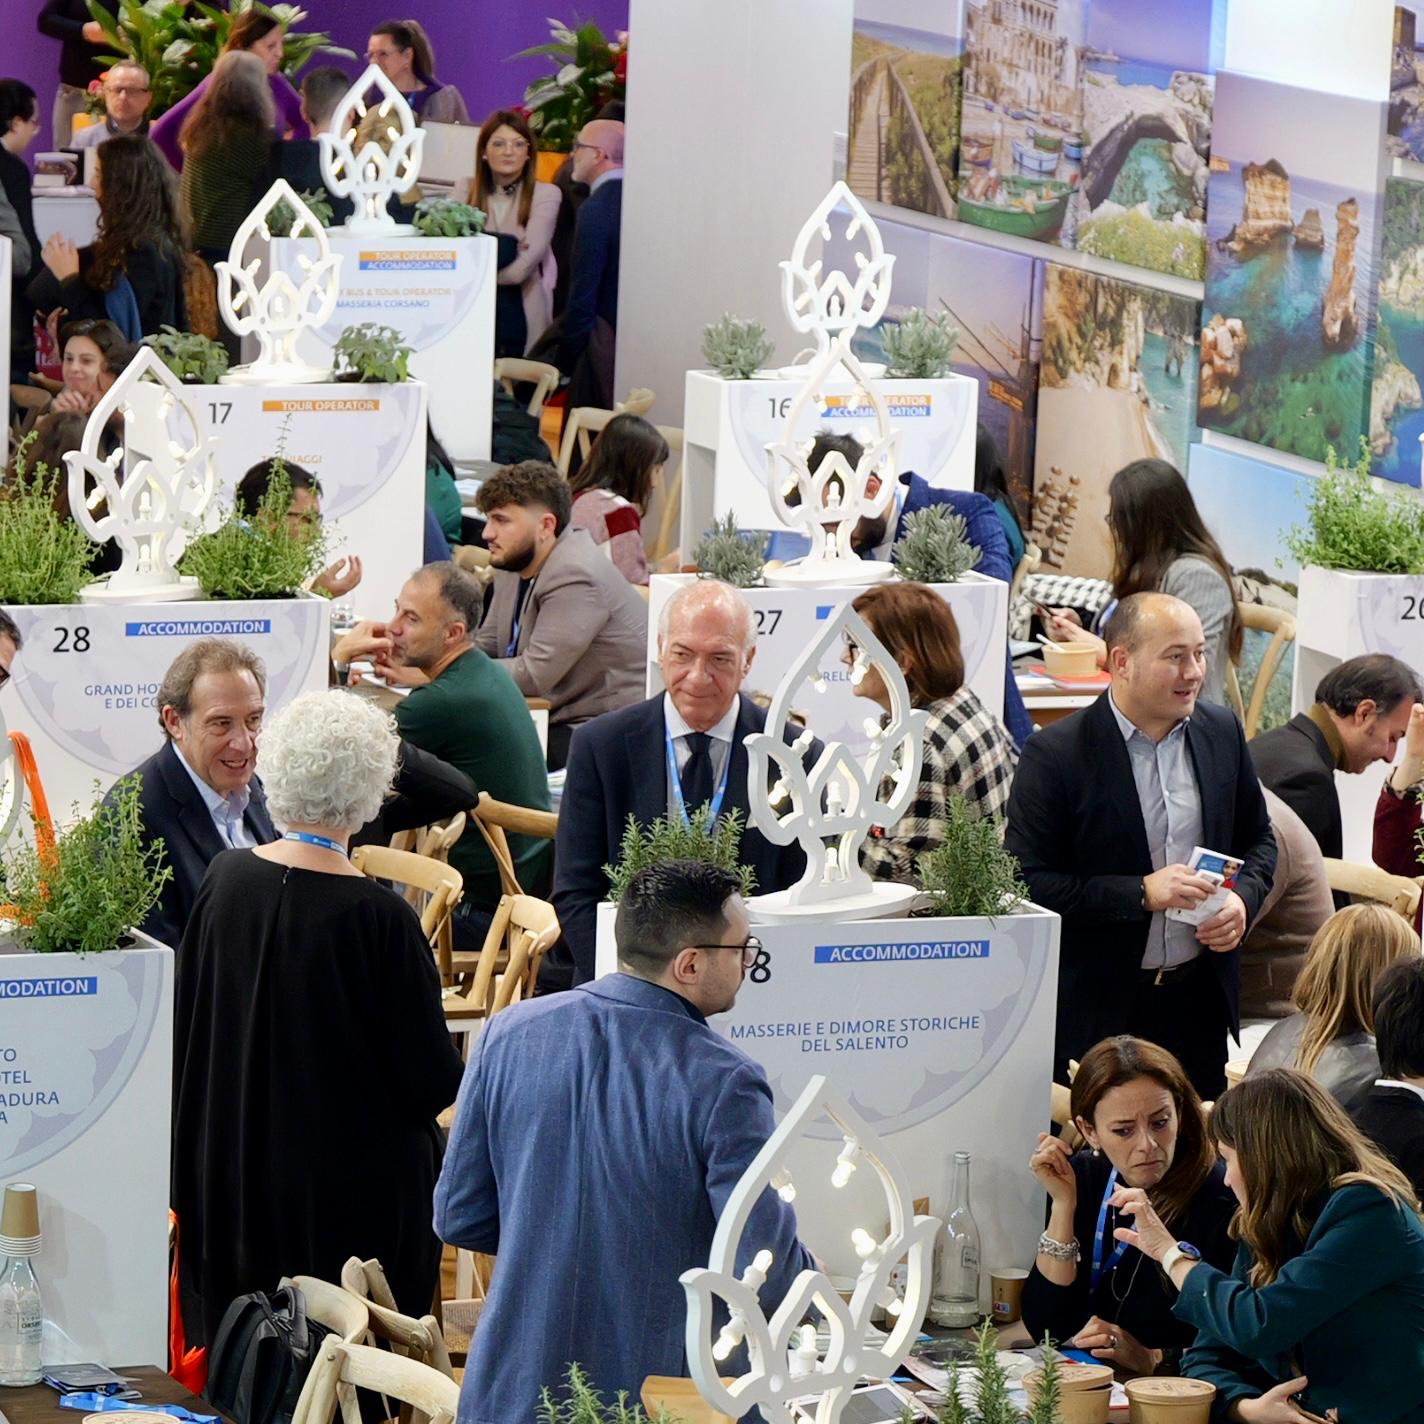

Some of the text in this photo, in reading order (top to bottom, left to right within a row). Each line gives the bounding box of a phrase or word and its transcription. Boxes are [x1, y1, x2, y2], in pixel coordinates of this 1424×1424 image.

[281, 400, 375, 411] TOUR OPERATOR
[886, 397, 926, 405] ERATOR
[208, 403, 233, 424] 17
[831, 406, 926, 417] ACCOMMDATION
[138, 621, 265, 635] ACCOMMODATION
[53, 626, 91, 653] 28
[84, 683, 163, 696] GRAND HOT
[105, 697, 159, 709] E DEI CO
[829, 942, 982, 962] ACCOMMODATION
[749, 950, 771, 984] 8
[730, 1015, 980, 1038] MASSERIE E DIMORE STORICHE
[801, 1035, 908, 1052] DEL SALENTO
